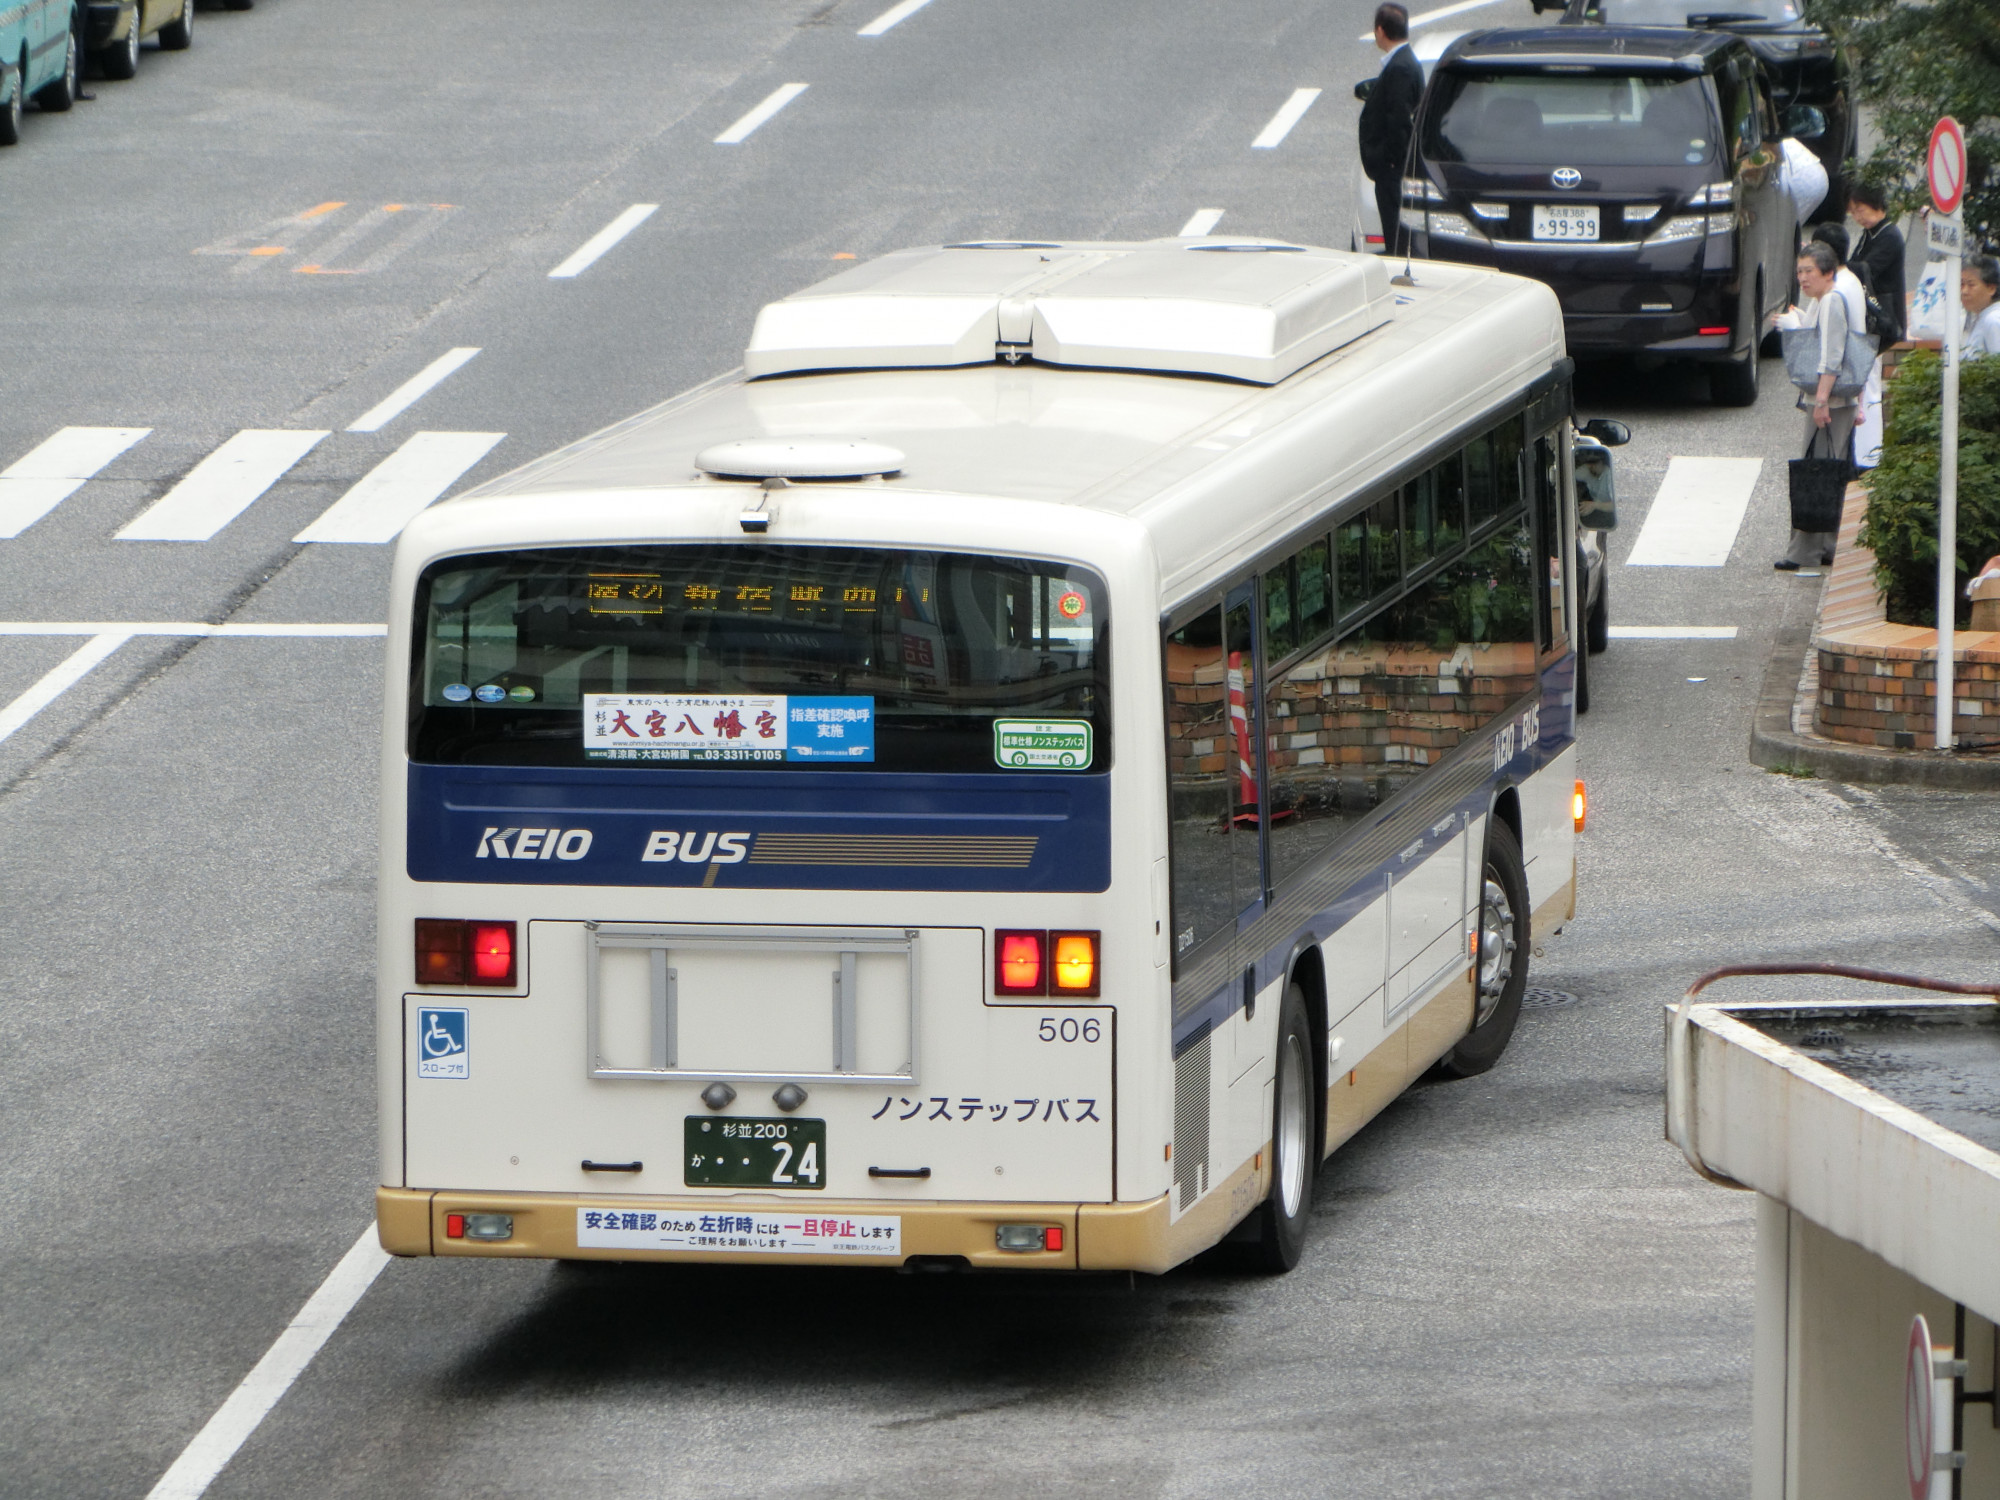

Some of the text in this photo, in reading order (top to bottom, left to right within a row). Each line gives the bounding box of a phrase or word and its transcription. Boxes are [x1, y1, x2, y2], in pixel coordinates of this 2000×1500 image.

[1548, 219, 1596, 236] 99-99
[595, 710, 607, 736] 杉並
[610, 709, 777, 739] 大宮八幡宮
[790, 708, 870, 723] 指差確認喚呼
[817, 723, 844, 738] 実施
[1494, 703, 1540, 772] KEIO BUS
[705, 750, 782, 760] 03-3311-0105
[476, 827, 750, 863] KEIO BUS
[1038, 1017, 1101, 1043] 506
[422, 1063, 464, 1073] スロープ付
[871, 1096, 1101, 1123] ノンステップバス
[771, 1141, 819, 1184] 24
[688, 1236, 788, 1248] ご理解をお願いします
